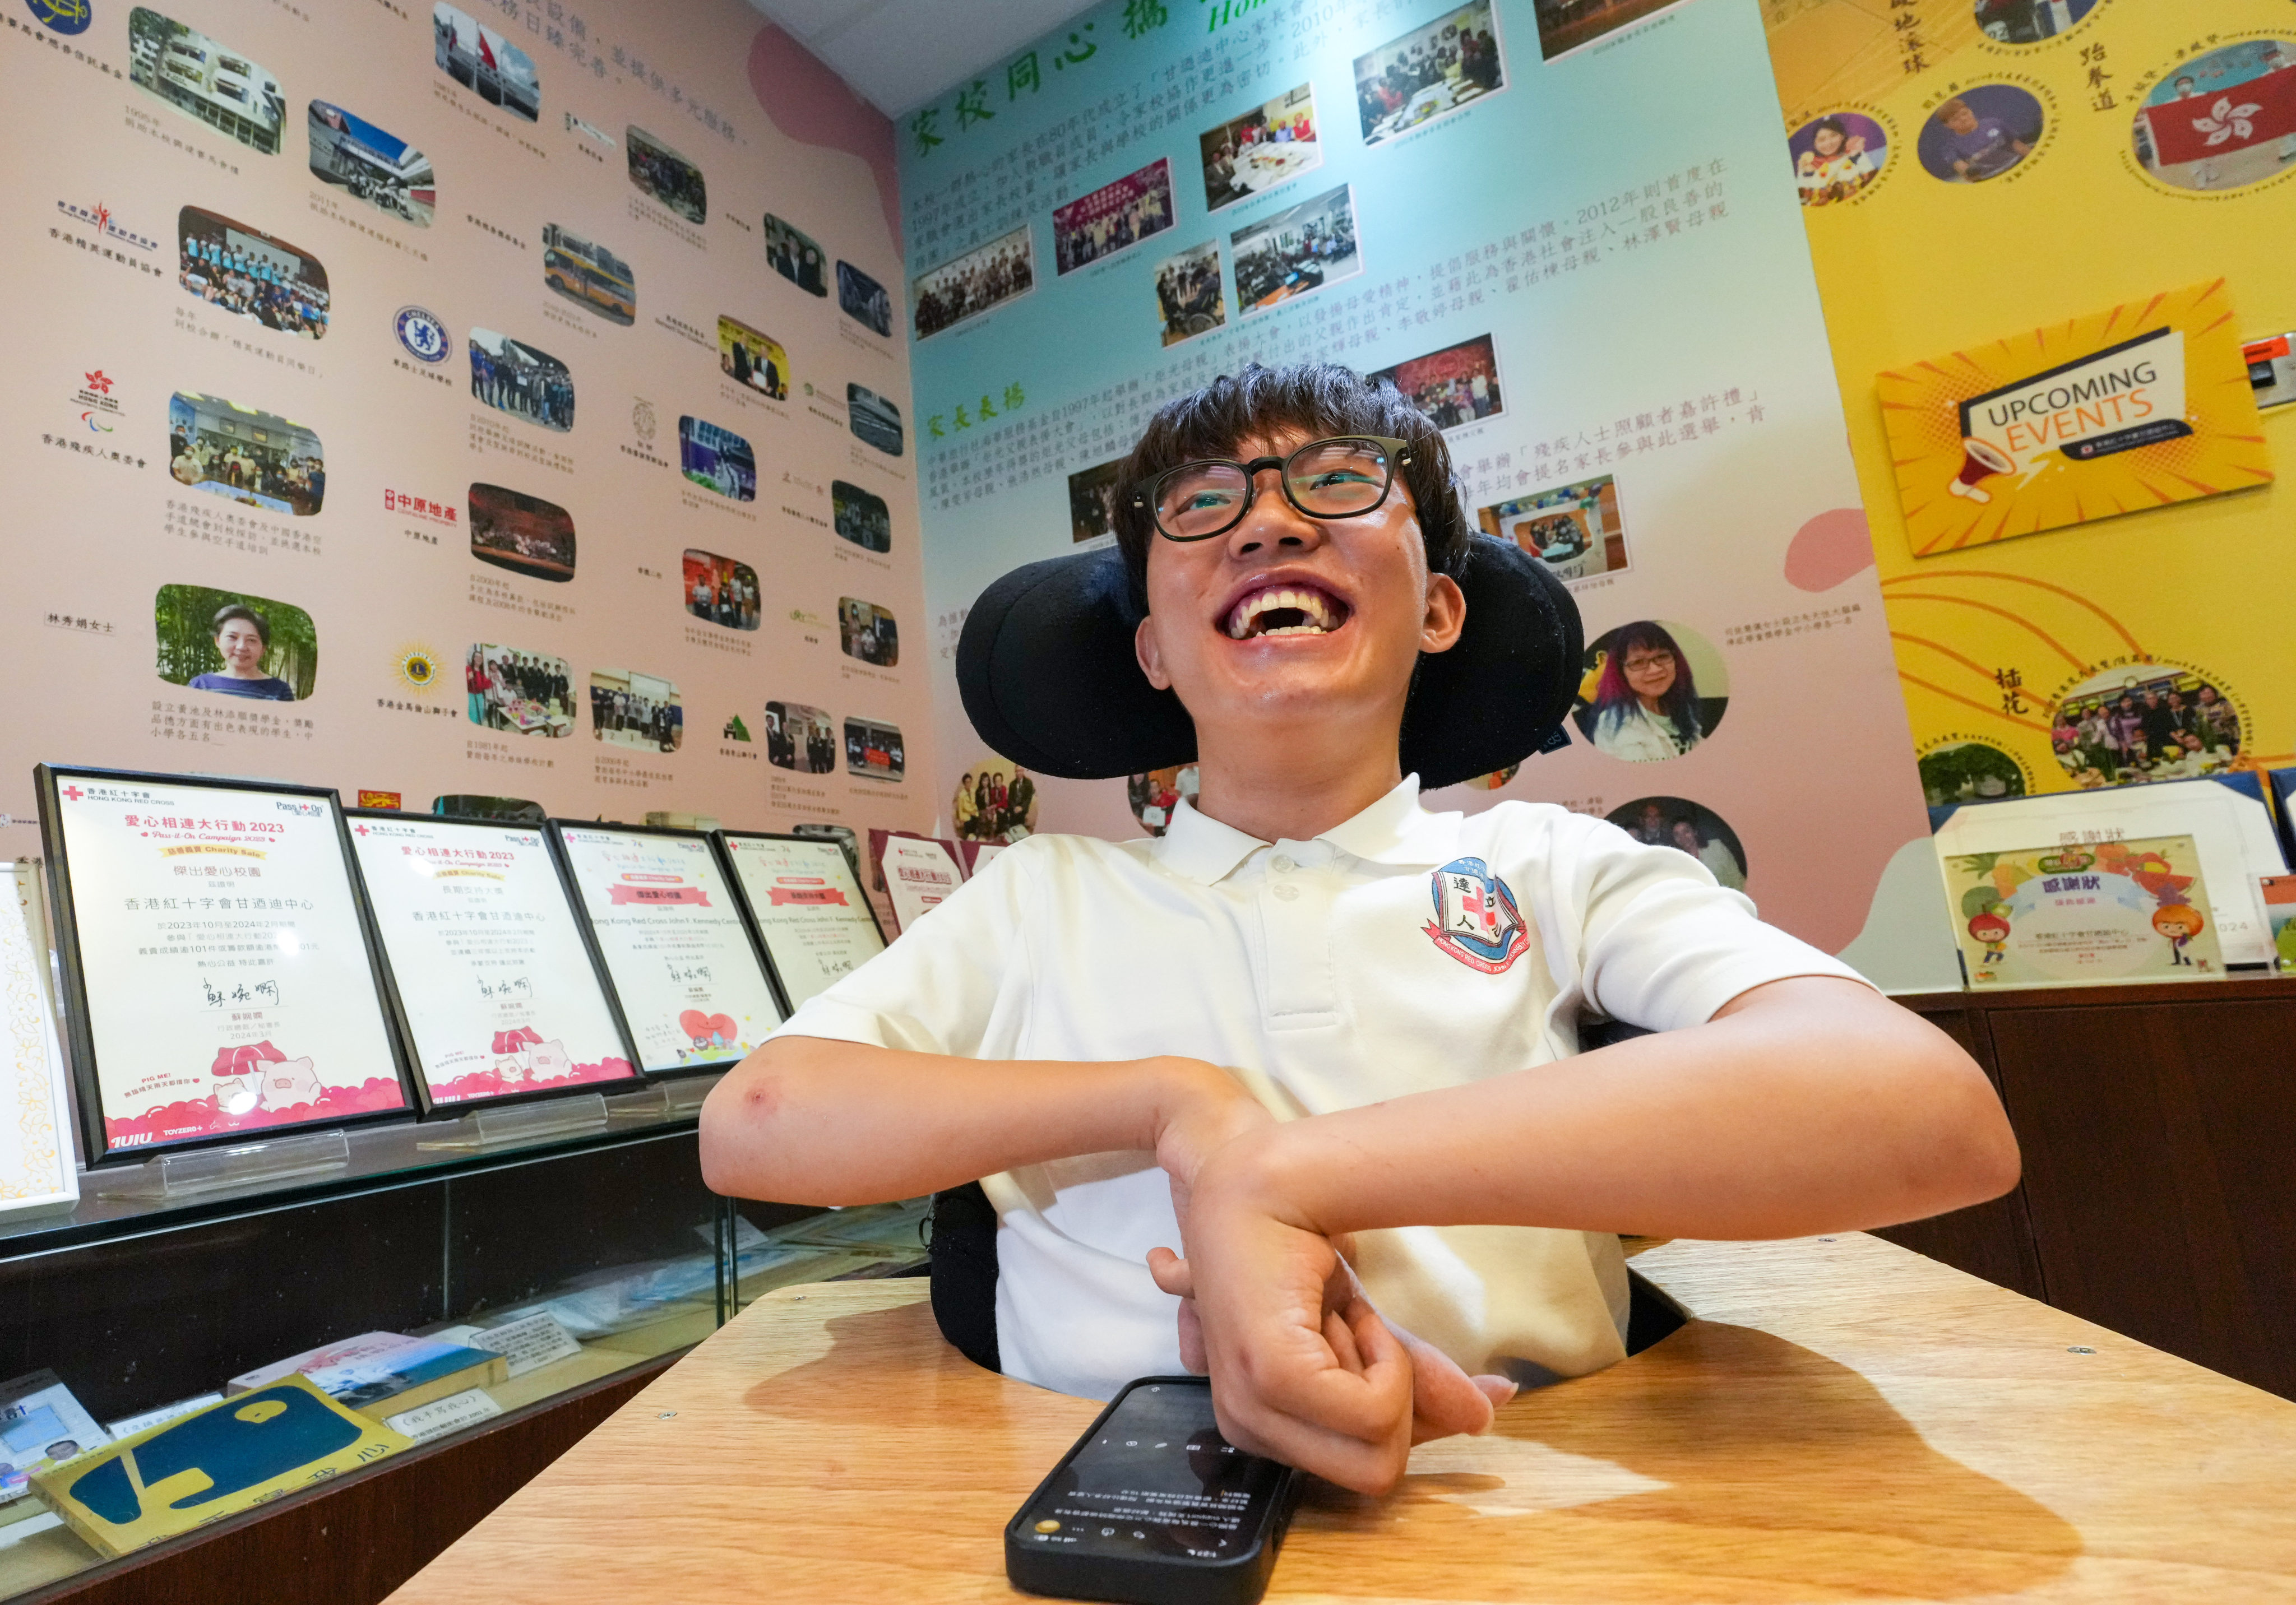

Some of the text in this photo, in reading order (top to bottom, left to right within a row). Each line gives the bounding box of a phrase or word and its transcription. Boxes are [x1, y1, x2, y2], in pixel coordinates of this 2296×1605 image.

[2079, 41, 2118, 112] 跆拳道
[49, 227, 164, 278] 香港精英運動員協會
[1988, 360, 2158, 428] UPCOMING
[2005, 388, 2154, 453] EVENTS
[41, 433, 147, 468] 香港殘疾人奧委會
[397, 493, 457, 522] 中原地產
[404, 529, 438, 545] 中原地產
[1994, 667, 2030, 717] 插花
[87, 787, 151, 799] 香港紅十字會
[276, 801, 298, 811] Pass
[311, 803, 323, 814] On
[124, 814, 285, 833] 愛心相連大行動 2023
[152, 831, 196, 841] Pass-it-On
[198, 832, 243, 843] Campaign
[205, 846, 239, 856] Charity
[240, 848, 261, 858] Sale
[401, 846, 515, 861] 愛心相連大行動 2023
[173, 865, 262, 878] 傑出愛心校園
[2043, 875, 2101, 895] 感謝狀
[124, 897, 314, 911] 香港紅十字會甘迺迪中心
[611, 917, 631, 926] Kong
[693, 917, 721, 926] Kennedy
[1436, 936, 1451, 949] HONG
[1450, 945, 1465, 957] KONG
[1464, 954, 1475, 964] RED
[1476, 961, 1492, 972] CROSS
[1493, 964, 1507, 972] JOHN
[141, 1072, 172, 1084] PIG ME!
